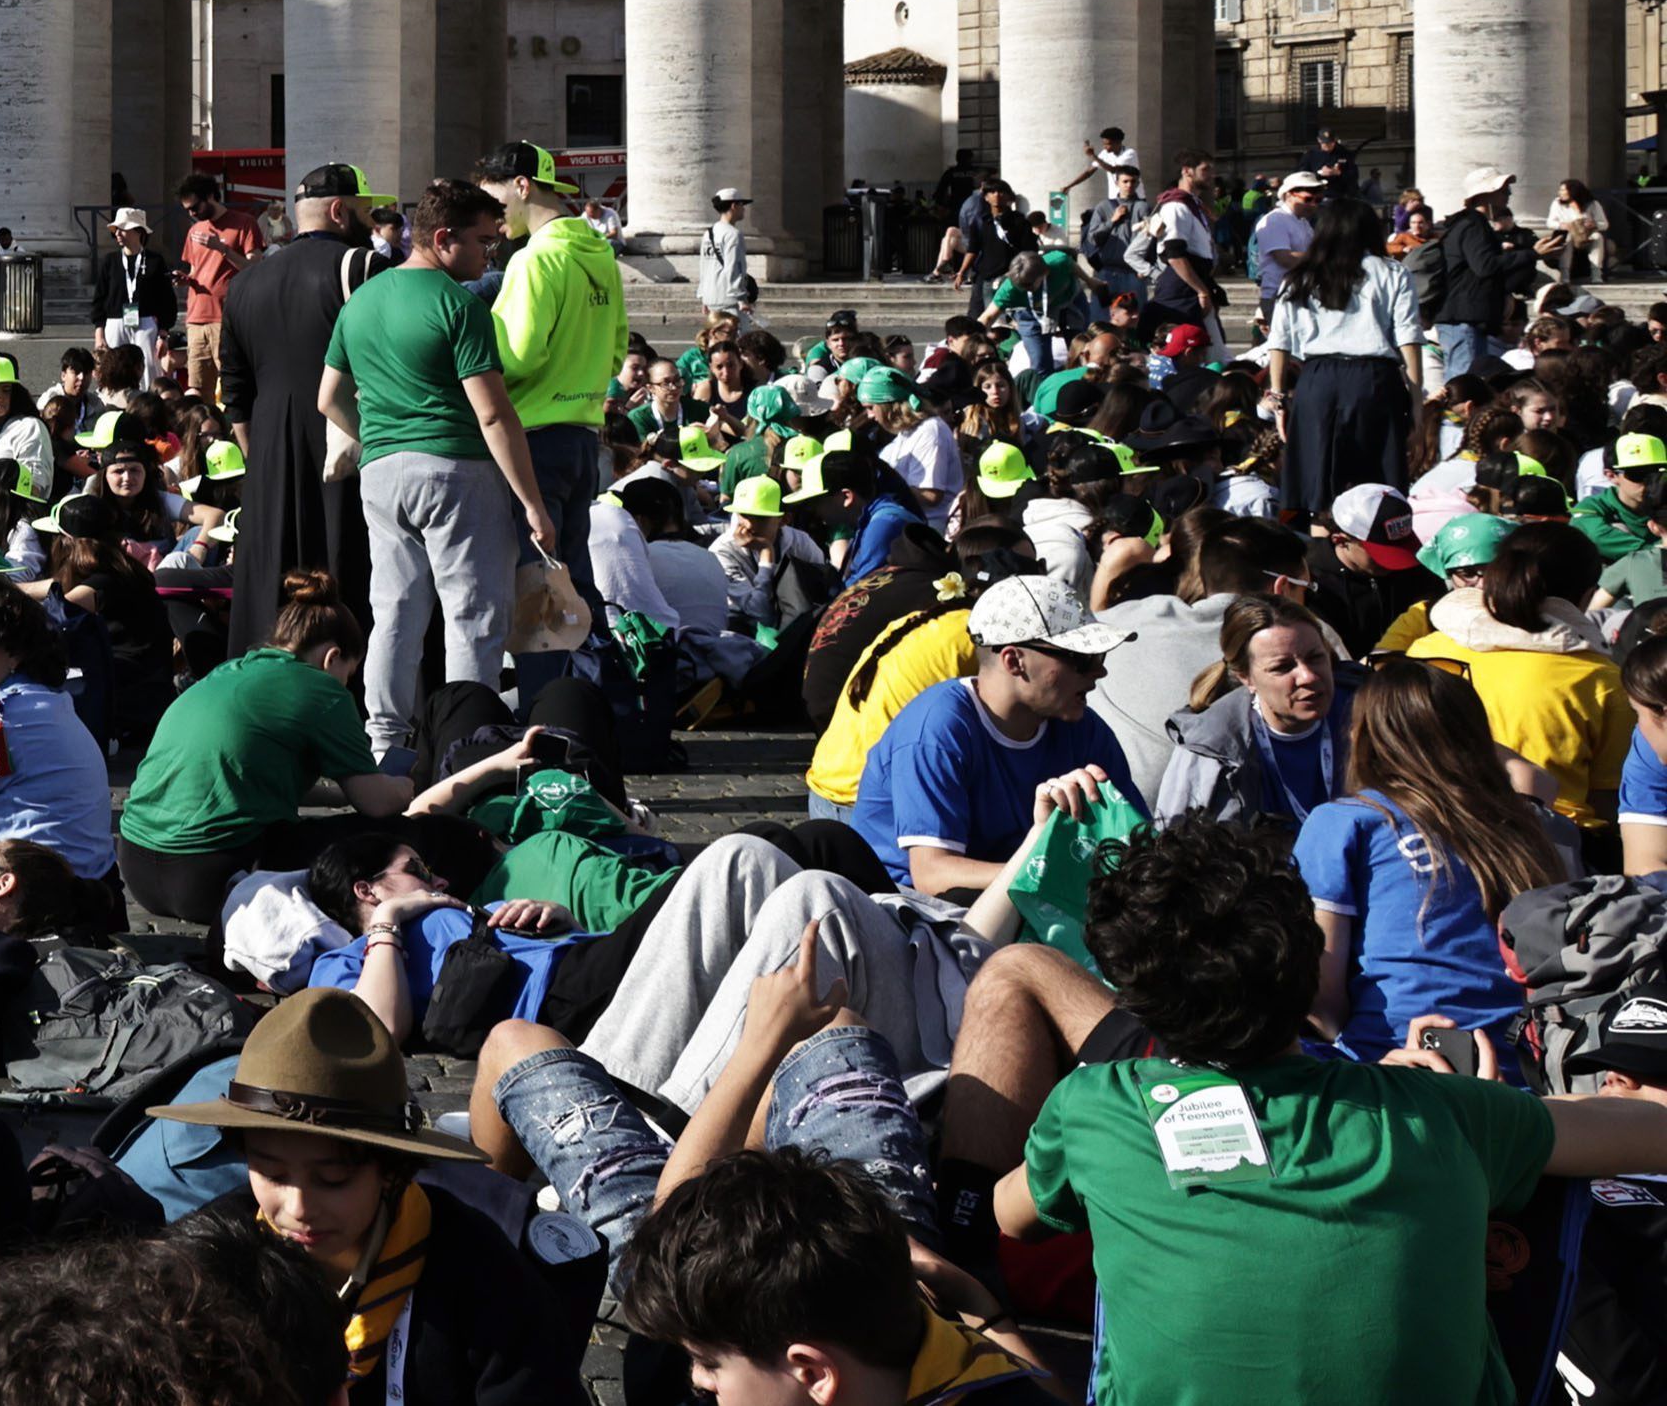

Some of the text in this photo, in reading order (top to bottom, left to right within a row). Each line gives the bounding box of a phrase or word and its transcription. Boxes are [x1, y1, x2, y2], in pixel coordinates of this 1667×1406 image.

[570, 156, 596, 165] VIGILI
[598, 155, 616, 164] DEL
[1179, 1100, 1222, 1113] Jubilee
[1164, 1107, 1244, 1124] of Teenagers
